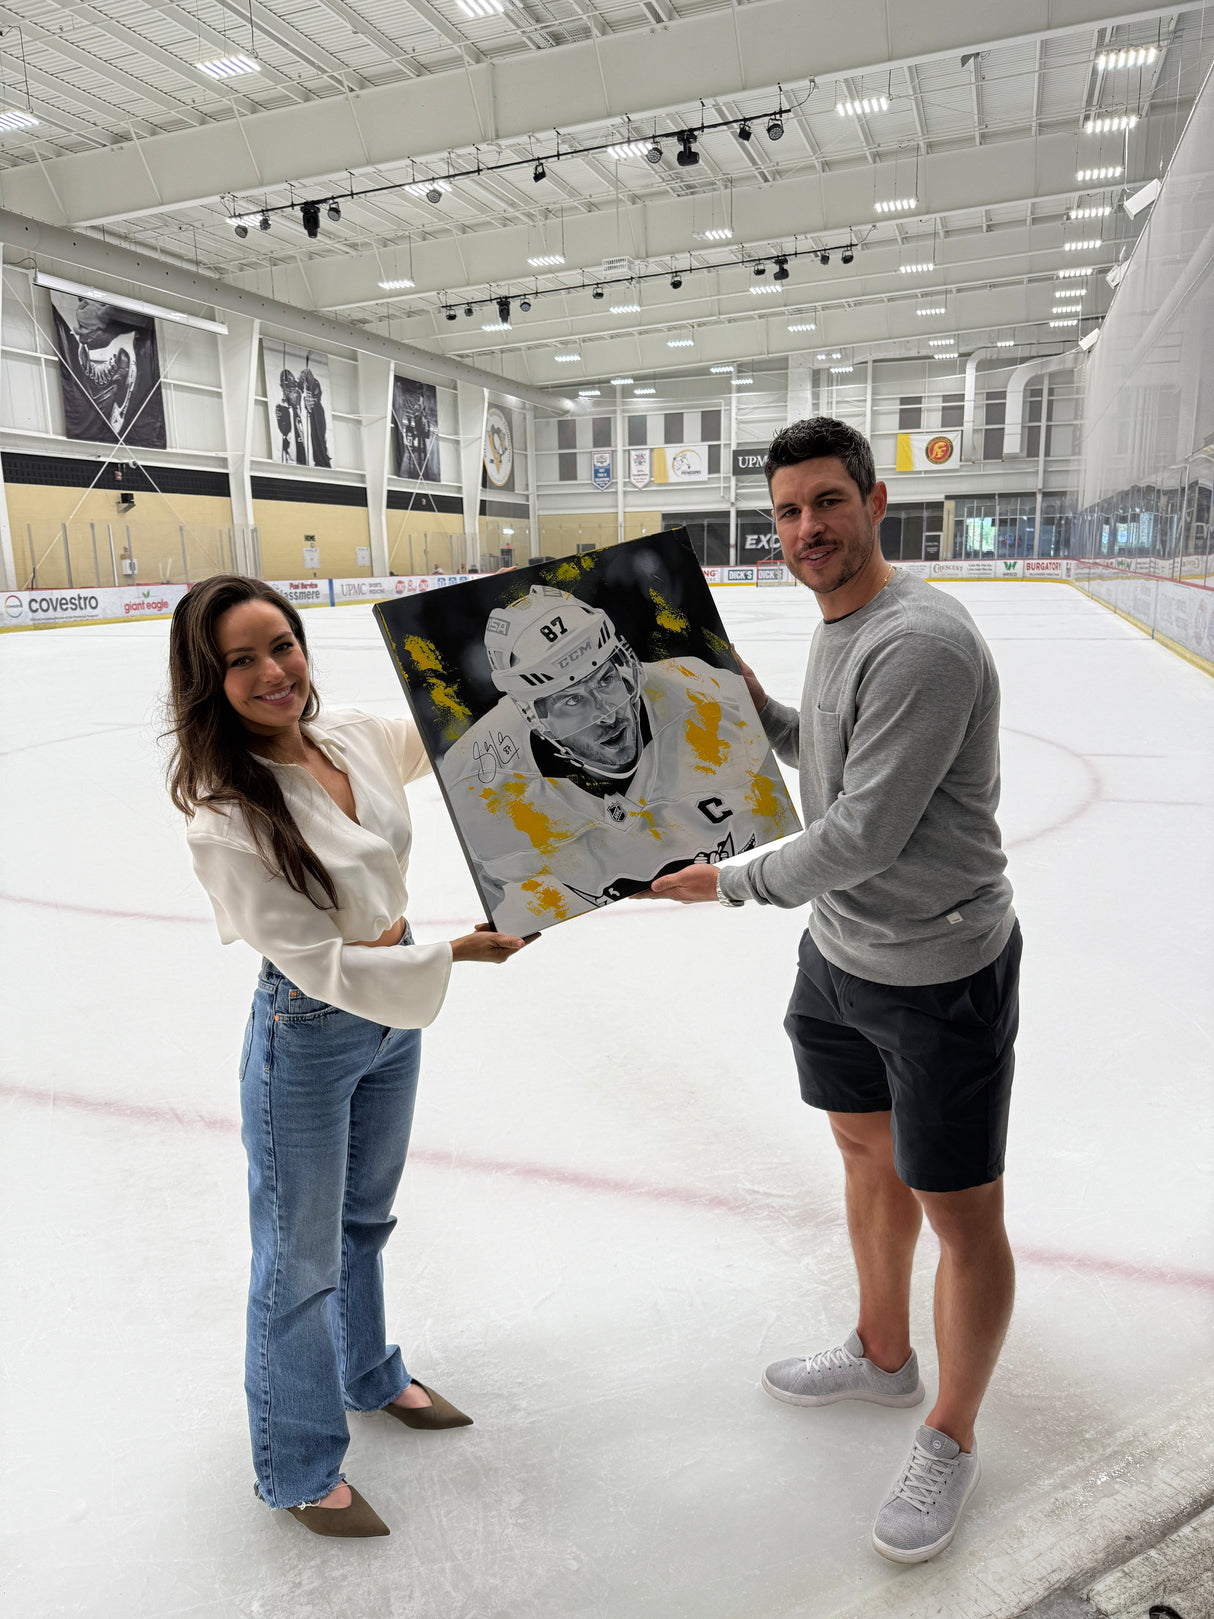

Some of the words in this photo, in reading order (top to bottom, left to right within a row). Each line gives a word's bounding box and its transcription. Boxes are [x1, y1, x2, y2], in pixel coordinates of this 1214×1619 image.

[737, 455, 769, 468] UPM
[744, 533, 781, 550] EXC
[1026, 562, 1061, 571] BURGATORY
[729, 570, 752, 580] DICK'S
[341, 583, 367, 597] UPMC
[28, 593, 99, 614] covestro
[124, 600, 145, 614] giant
[146, 598, 169, 612] eagle
[540, 616, 568, 643] 87
[557, 639, 592, 669] CCM
[697, 797, 734, 824] C
